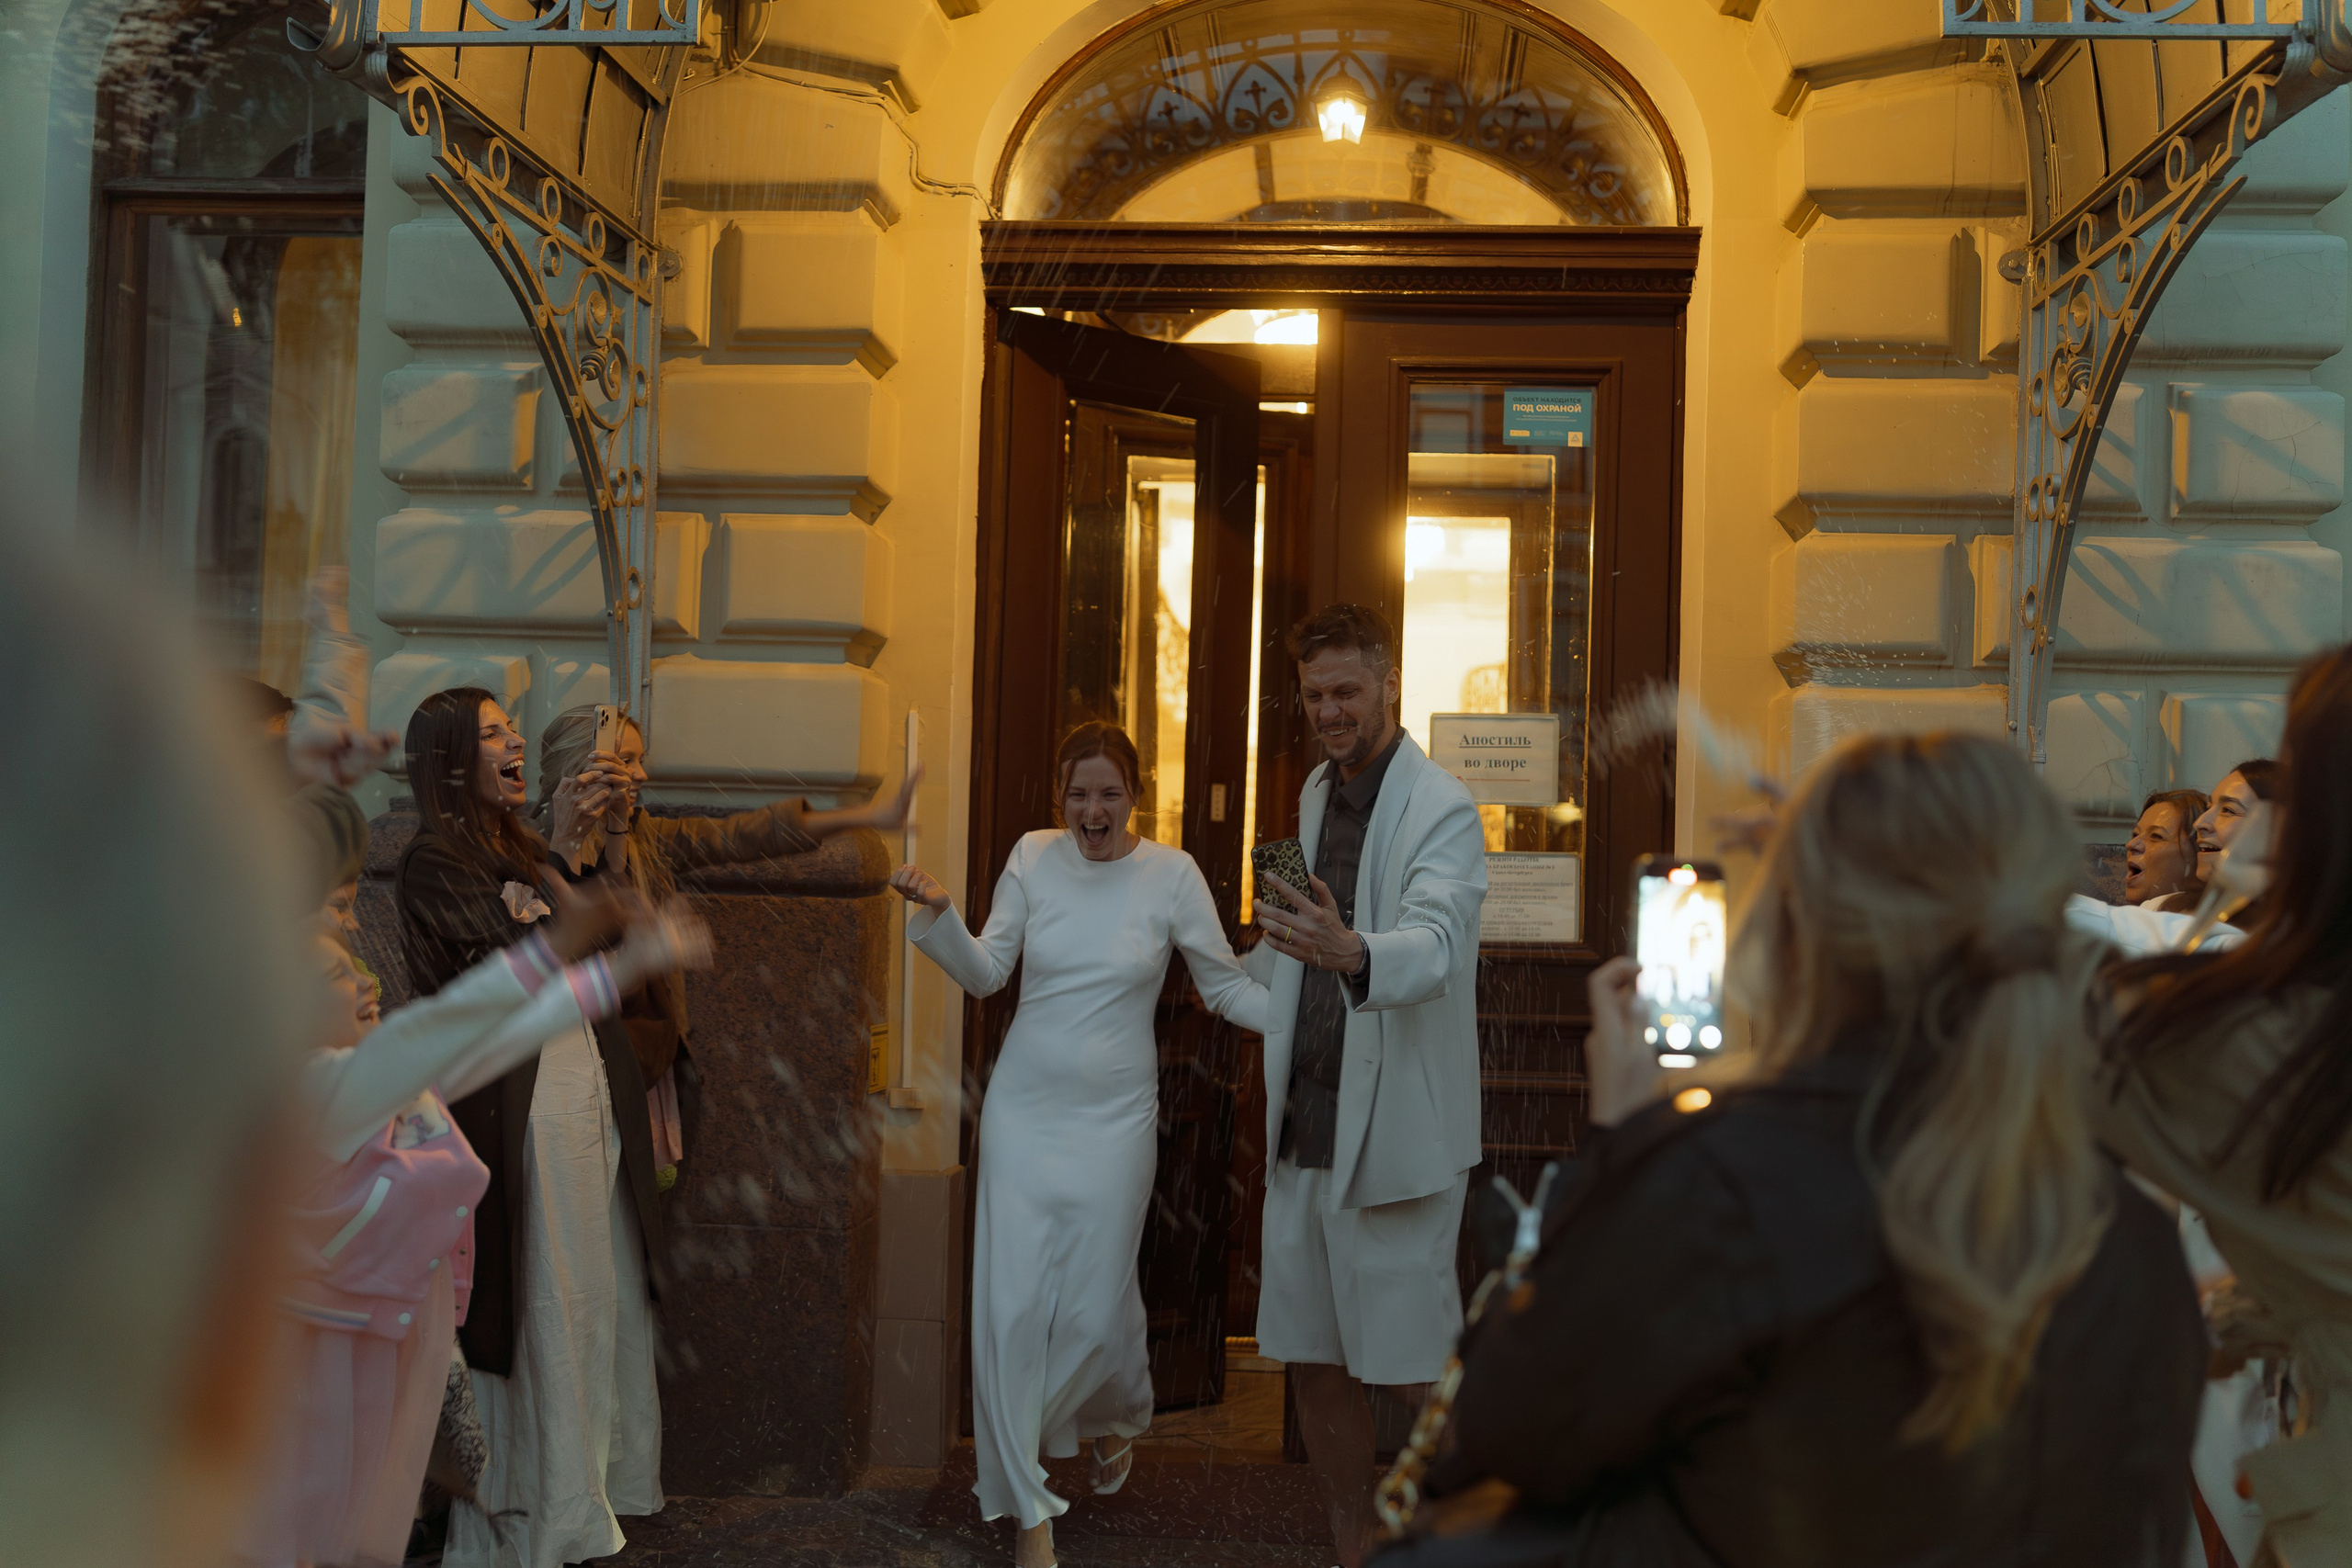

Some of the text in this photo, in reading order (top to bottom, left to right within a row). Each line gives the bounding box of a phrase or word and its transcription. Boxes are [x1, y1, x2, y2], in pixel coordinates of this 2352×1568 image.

[1512, 403, 1582, 413] ПОД ОХРАНОЙ
[1459, 734, 1532, 746] Апостиль
[1464, 759, 1527, 772] во дворе
